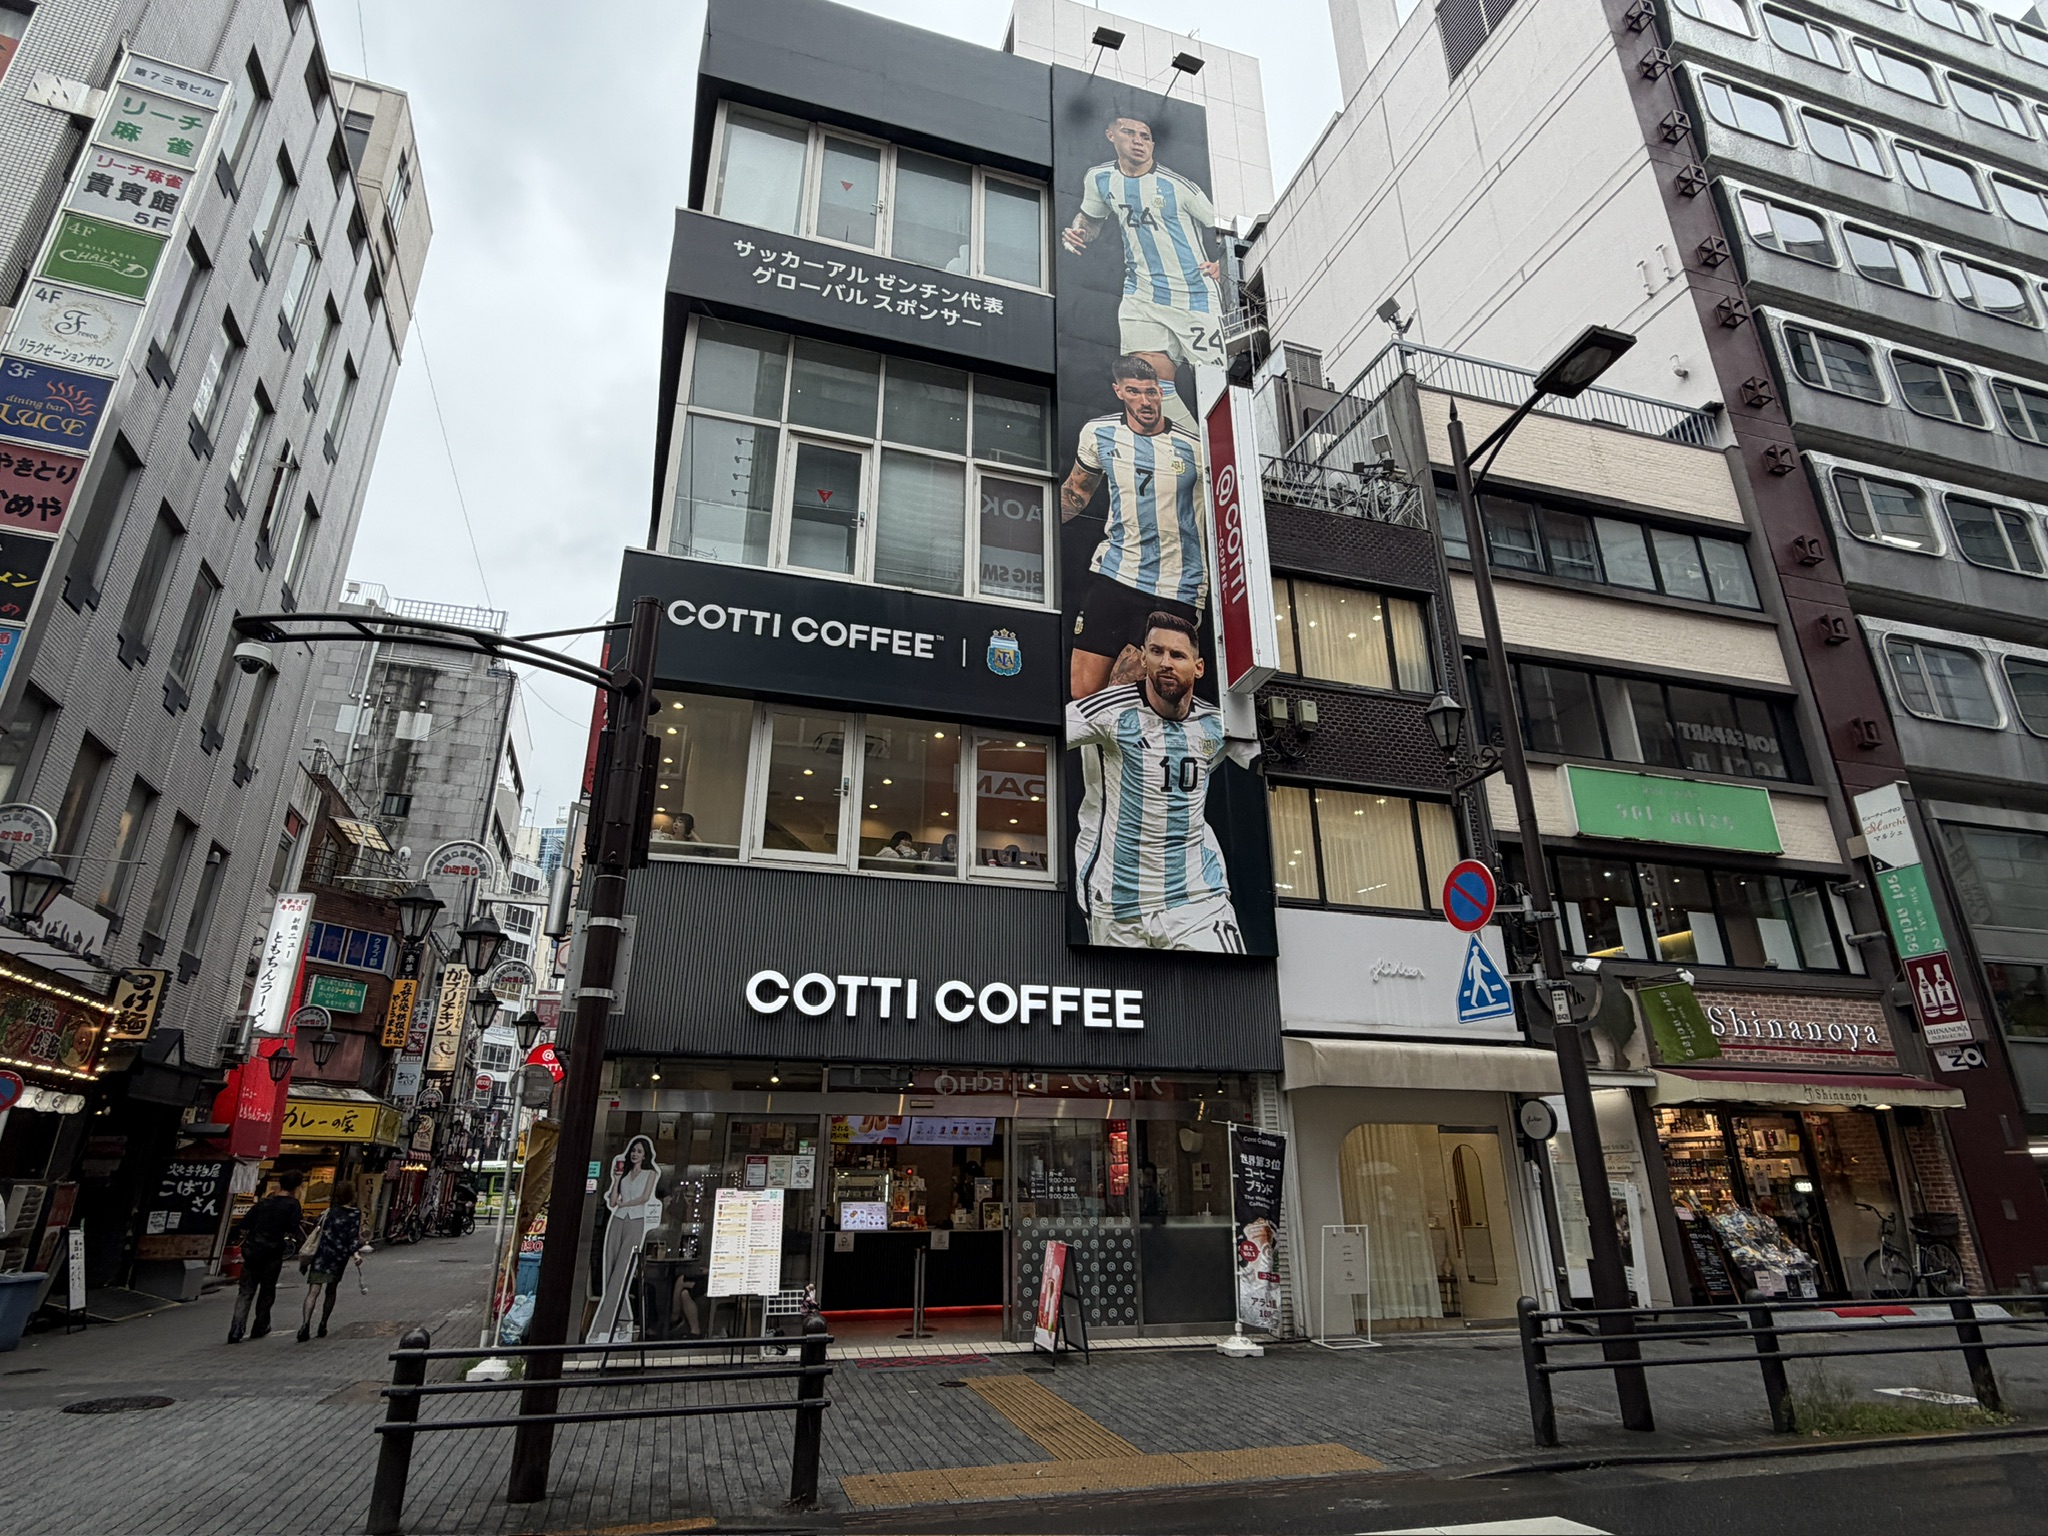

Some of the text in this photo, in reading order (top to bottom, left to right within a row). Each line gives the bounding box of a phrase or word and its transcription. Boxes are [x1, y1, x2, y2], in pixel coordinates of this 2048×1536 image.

[122, 97, 203, 130] リーチ
[97, 155, 183, 189] リーチ麻雀
[83, 172, 179, 215] 貴賓館
[67, 222, 96, 238] 4F
[133, 212, 171, 229] 5F
[1118, 204, 1160, 231] 24
[35, 287, 63, 303] 4F
[54, 310, 98, 339] Fresco
[19, 338, 114, 370] リラクゼーションサロン
[7, 363, 37, 379] 3F
[6, 394, 66, 412] dining bar
[0, 403, 86, 437] LUCE
[1136, 468, 1153, 496] 7
[0, 489, 62, 521] めや
[1224, 503, 1246, 604] COTTI
[667, 600, 935, 659] COTTI COFFEE
[1160, 756, 1198, 792] 10
[1876, 861, 1883, 870] 3
[1932, 938, 1942, 949] 2
[253, 931, 283, 1029] ともちんラーメン
[746, 970, 1144, 1028] COTTI COFFEE
[1707, 1006, 1880, 1051] Shinanoya
[1814, 1087, 1868, 1101] Shinanoya
[283, 1106, 358, 1133] カレーの家
[1239, 1153, 1281, 1171] 世界第3位
[1245, 1167, 1276, 1180] コーヒー
[158, 1179, 216, 1197] こばり
[1245, 1180, 1274, 1195] ブランド
[191, 1196, 219, 1217] さん
